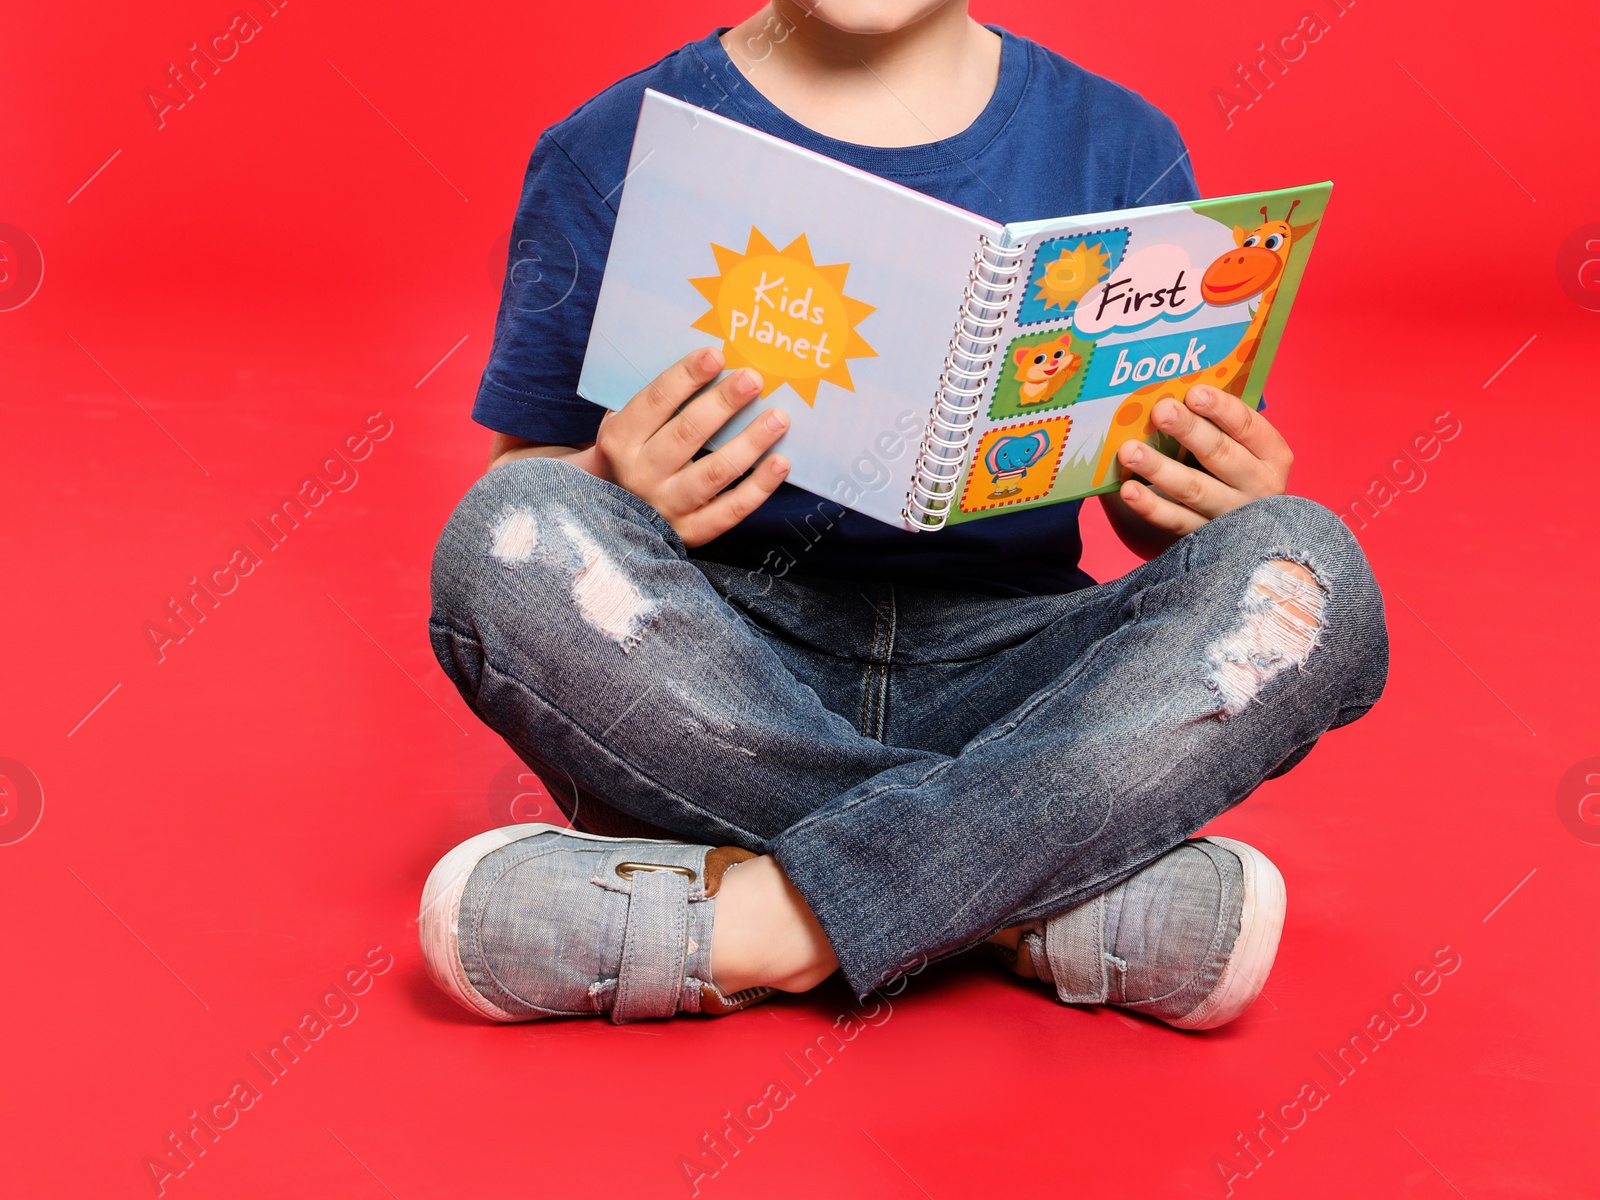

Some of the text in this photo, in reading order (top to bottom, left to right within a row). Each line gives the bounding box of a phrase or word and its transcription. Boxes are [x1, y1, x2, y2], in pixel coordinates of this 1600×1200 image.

[753, 271, 825, 325] Kids
[1095, 269, 1188, 322] First
[729, 304, 832, 369] planet
[1108, 337, 1207, 387] book
